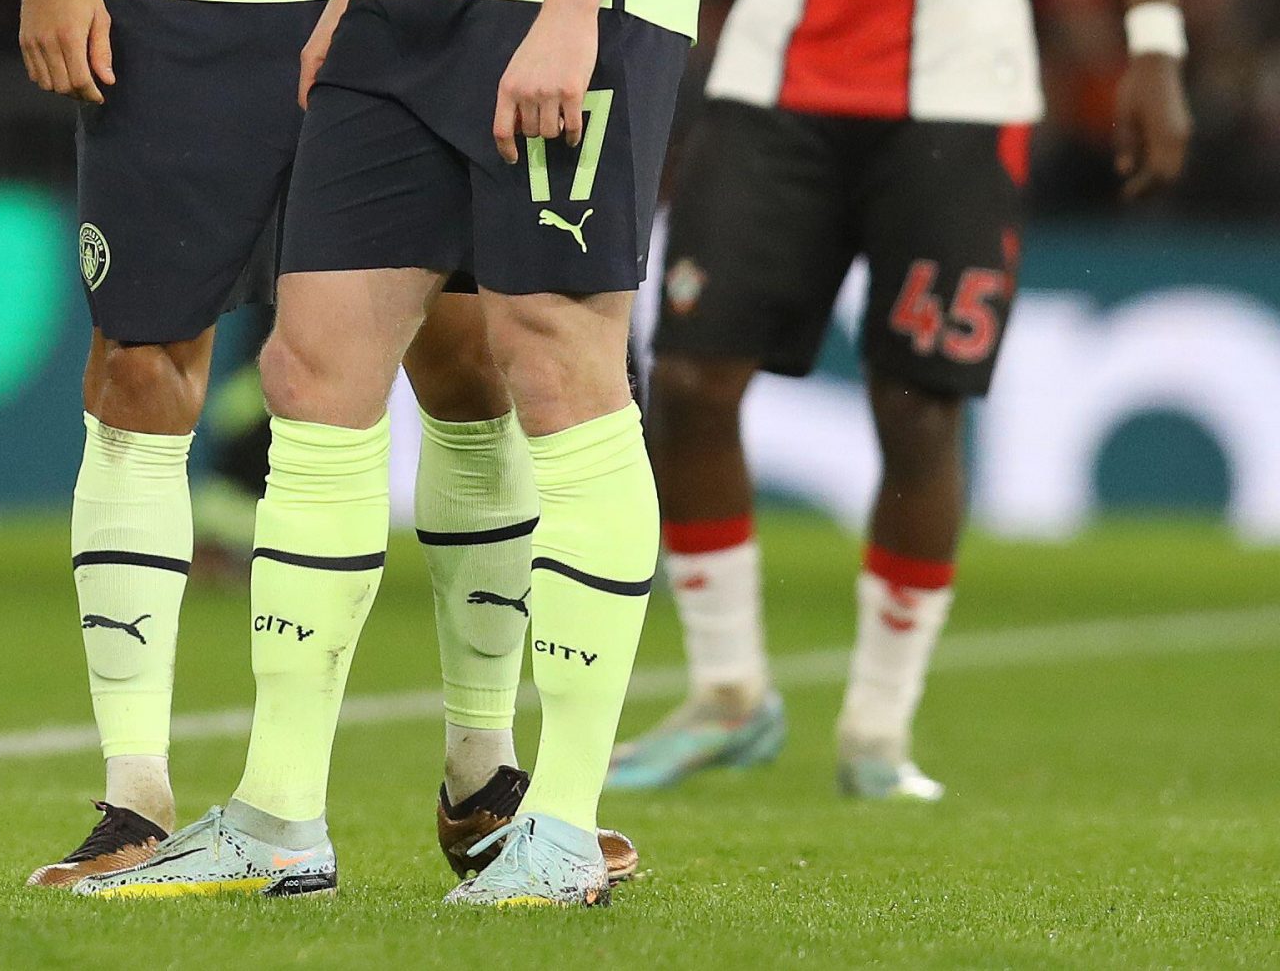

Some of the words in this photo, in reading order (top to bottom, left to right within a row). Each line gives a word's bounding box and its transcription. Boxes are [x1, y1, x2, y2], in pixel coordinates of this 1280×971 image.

[525, 88, 615, 202] 17
[890, 259, 1012, 364] 45
[253, 615, 315, 642] CITY
[534, 639, 598, 666] CITY
